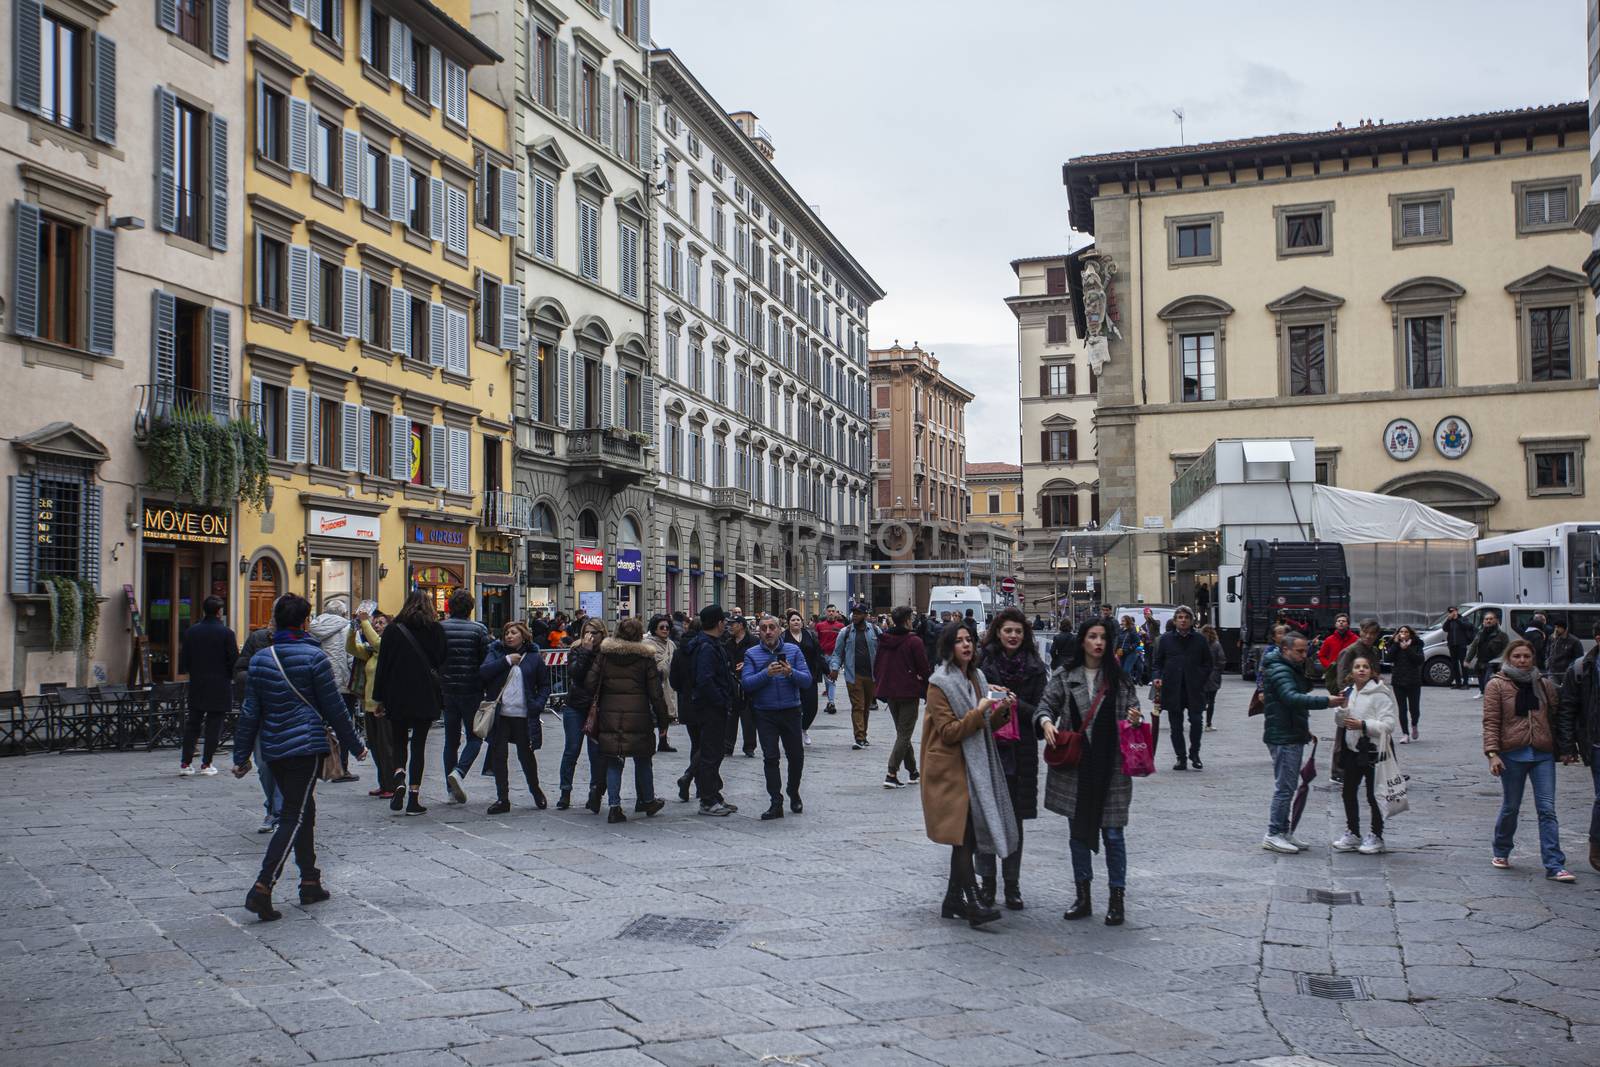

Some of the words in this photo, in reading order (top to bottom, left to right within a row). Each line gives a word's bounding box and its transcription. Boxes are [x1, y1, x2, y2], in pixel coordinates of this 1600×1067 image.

[145, 508, 199, 534] MOVE
[201, 514, 228, 536] ON
[579, 554, 603, 566] CHANGE
[617, 559, 635, 572] change
